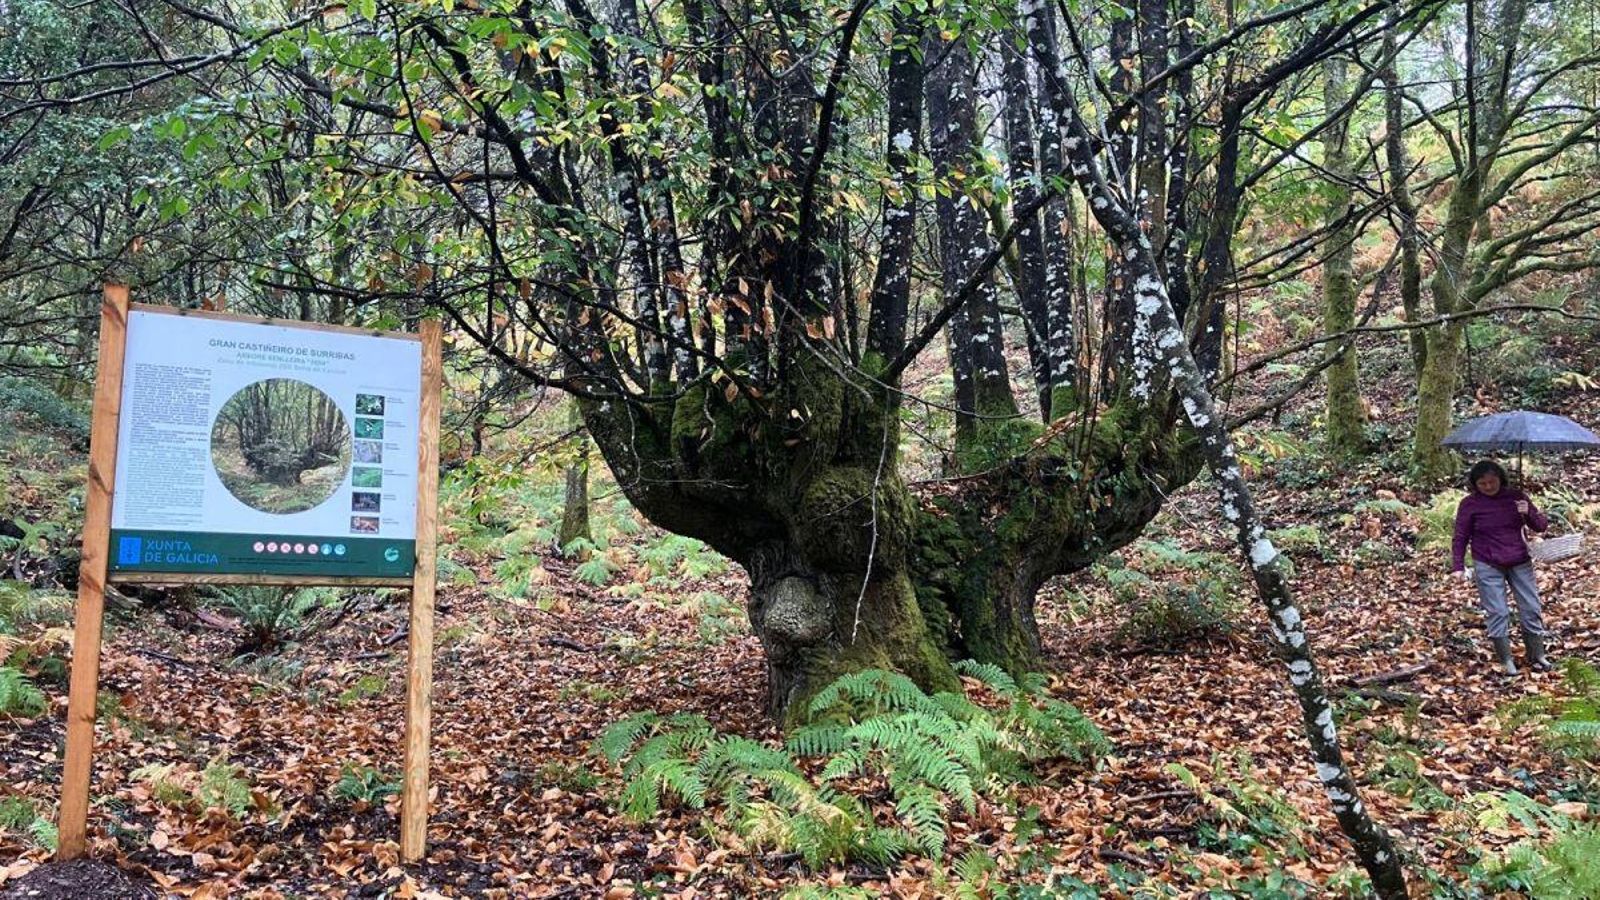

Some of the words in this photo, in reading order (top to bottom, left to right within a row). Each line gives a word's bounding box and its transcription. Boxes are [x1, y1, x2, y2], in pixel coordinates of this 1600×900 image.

[209, 338, 237, 349] GRAN
[296, 347, 309, 356] DE
[310, 348, 356, 361] SURRIBAS
[147, 540, 192, 552] XUNTA
[144, 551, 161, 563] DE
[166, 552, 219, 564] GALICIA
